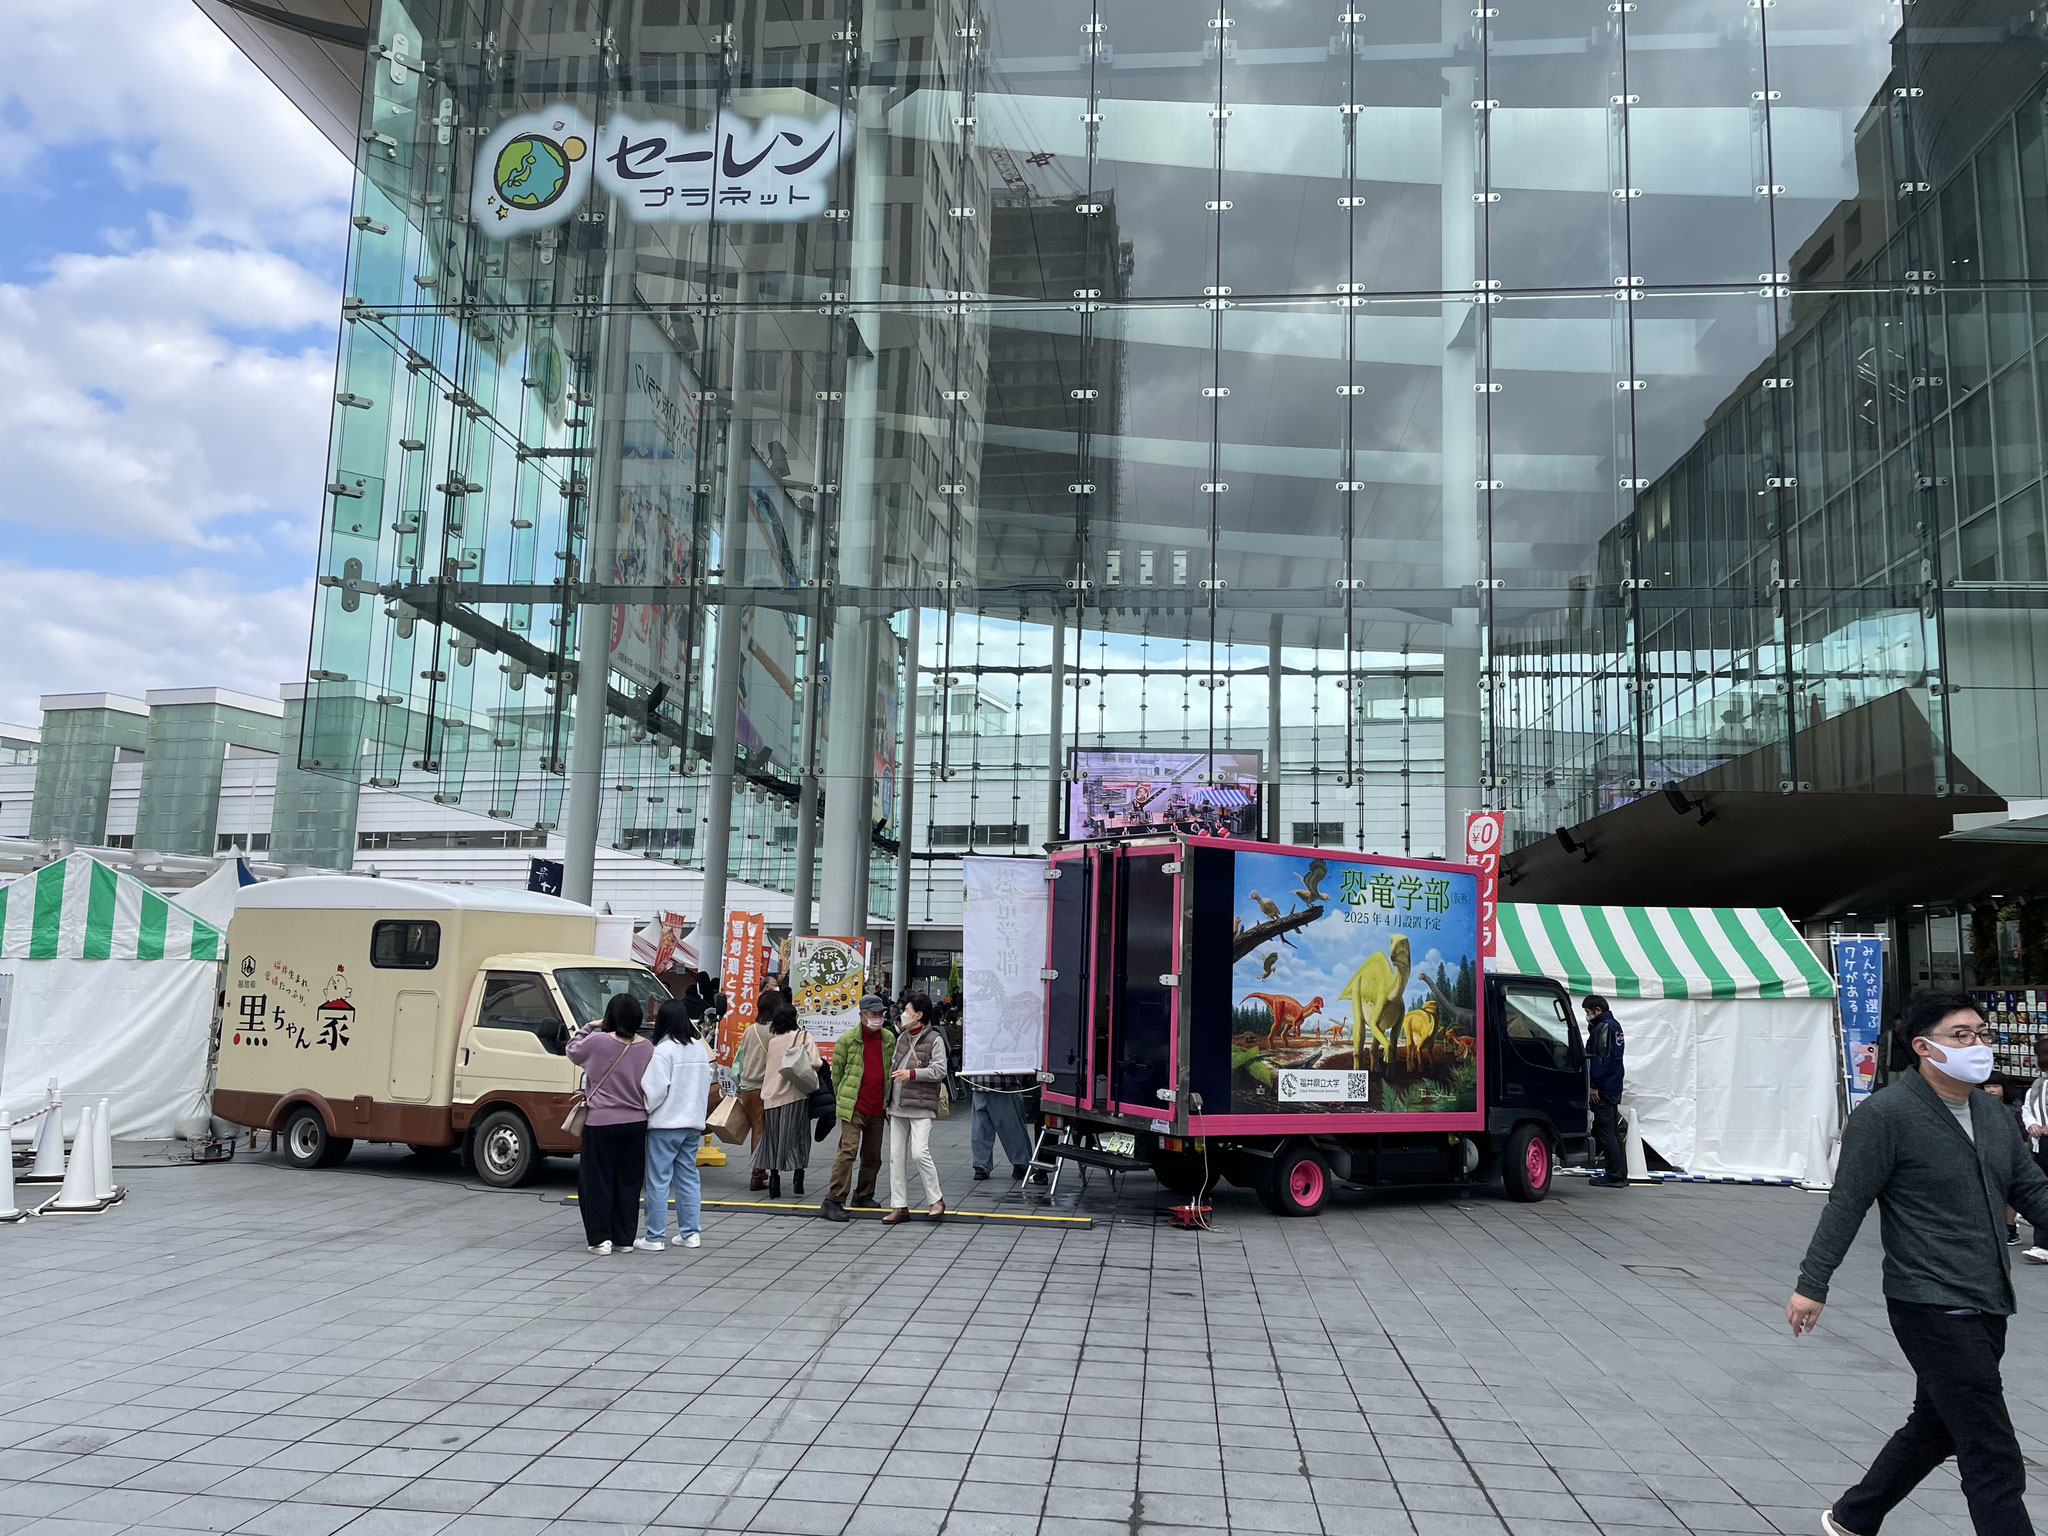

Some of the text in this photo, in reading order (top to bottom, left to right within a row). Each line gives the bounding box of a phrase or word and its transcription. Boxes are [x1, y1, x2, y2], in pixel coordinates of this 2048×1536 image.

[606, 130, 835, 179] セーレン
[640, 185, 810, 207] プラネット
[1340, 869, 1451, 914] 恐竜学部
[1344, 911, 1441, 931] 2025年4月設置予定
[798, 957, 859, 978] うまいもん
[825, 973, 840, 984] 祭り
[1863, 946, 1879, 1029] みんなが選ぶ
[233, 993, 356, 1051] 黒ちゃん家
[1300, 1078, 1340, 1088] 福井県立大学
